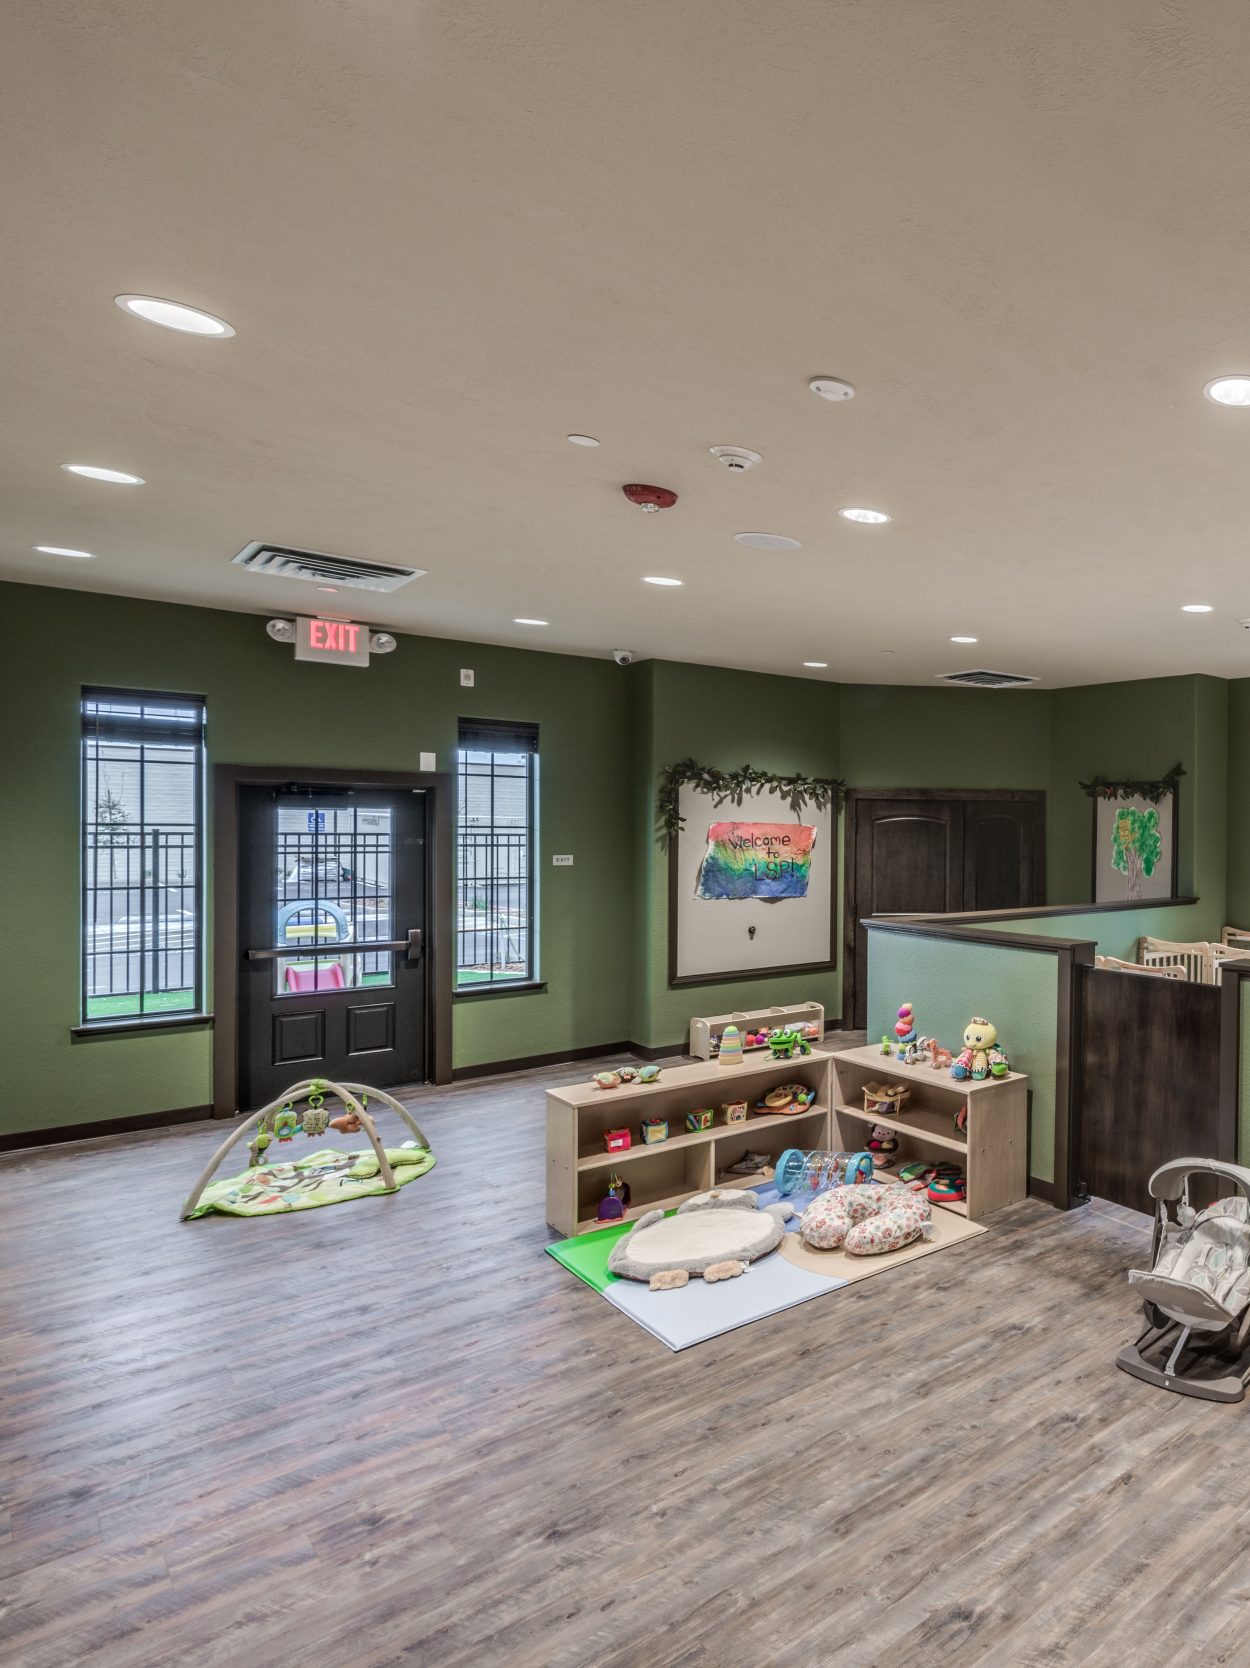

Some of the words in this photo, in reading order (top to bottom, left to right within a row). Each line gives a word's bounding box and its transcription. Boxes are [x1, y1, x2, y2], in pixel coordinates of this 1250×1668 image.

[310, 620, 360, 653] EXIT
[728, 833, 791, 850] Welcome
[766, 847, 780, 859] to
[753, 857, 794, 881] LSP!
